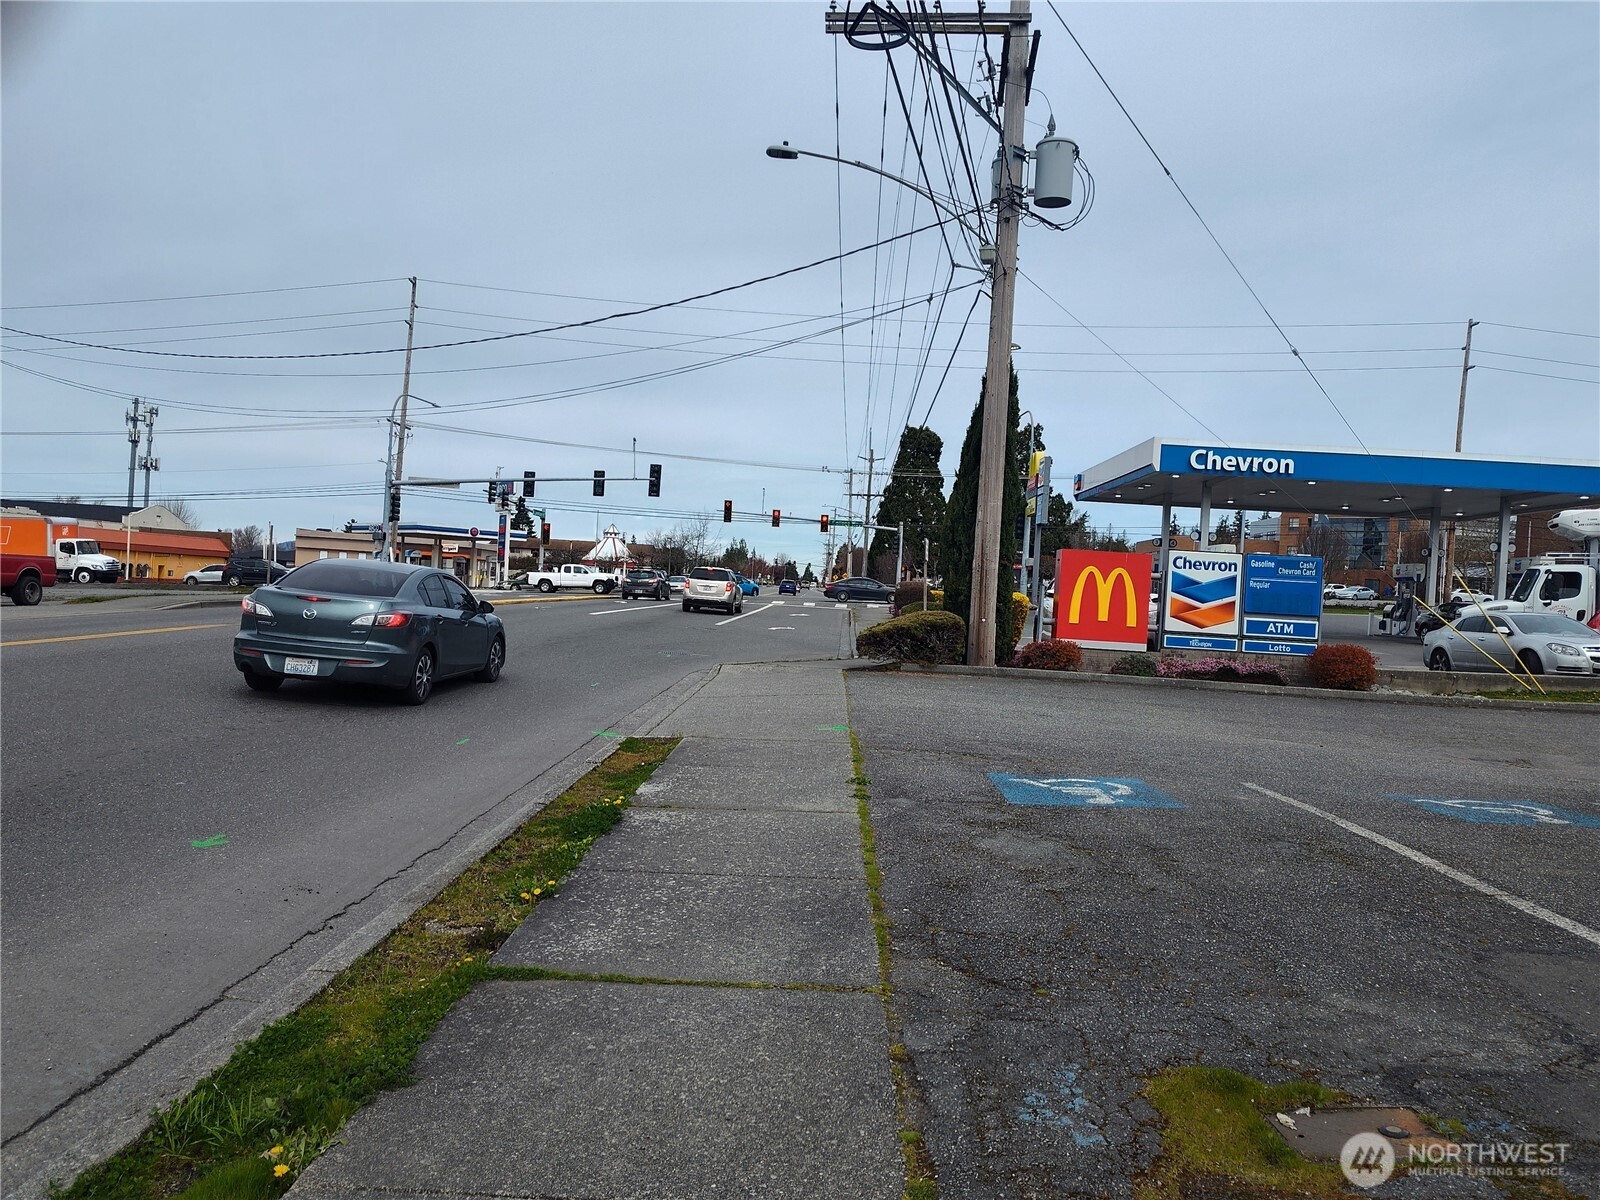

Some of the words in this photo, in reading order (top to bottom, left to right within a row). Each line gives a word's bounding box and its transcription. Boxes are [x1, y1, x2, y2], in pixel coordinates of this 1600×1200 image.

[1189, 448, 1295, 475] Chevron
[1172, 555, 1238, 573] Chevron
[1250, 559, 1275, 568] Gasoline
[1299, 561, 1316, 569] Cash/
[1278, 567, 1301, 575] Chevron
[1302, 568, 1316, 576] Card
[1249, 581, 1270, 589] Regular
[1266, 622, 1294, 634] ATM
[1268, 644, 1291, 652] Lotto
